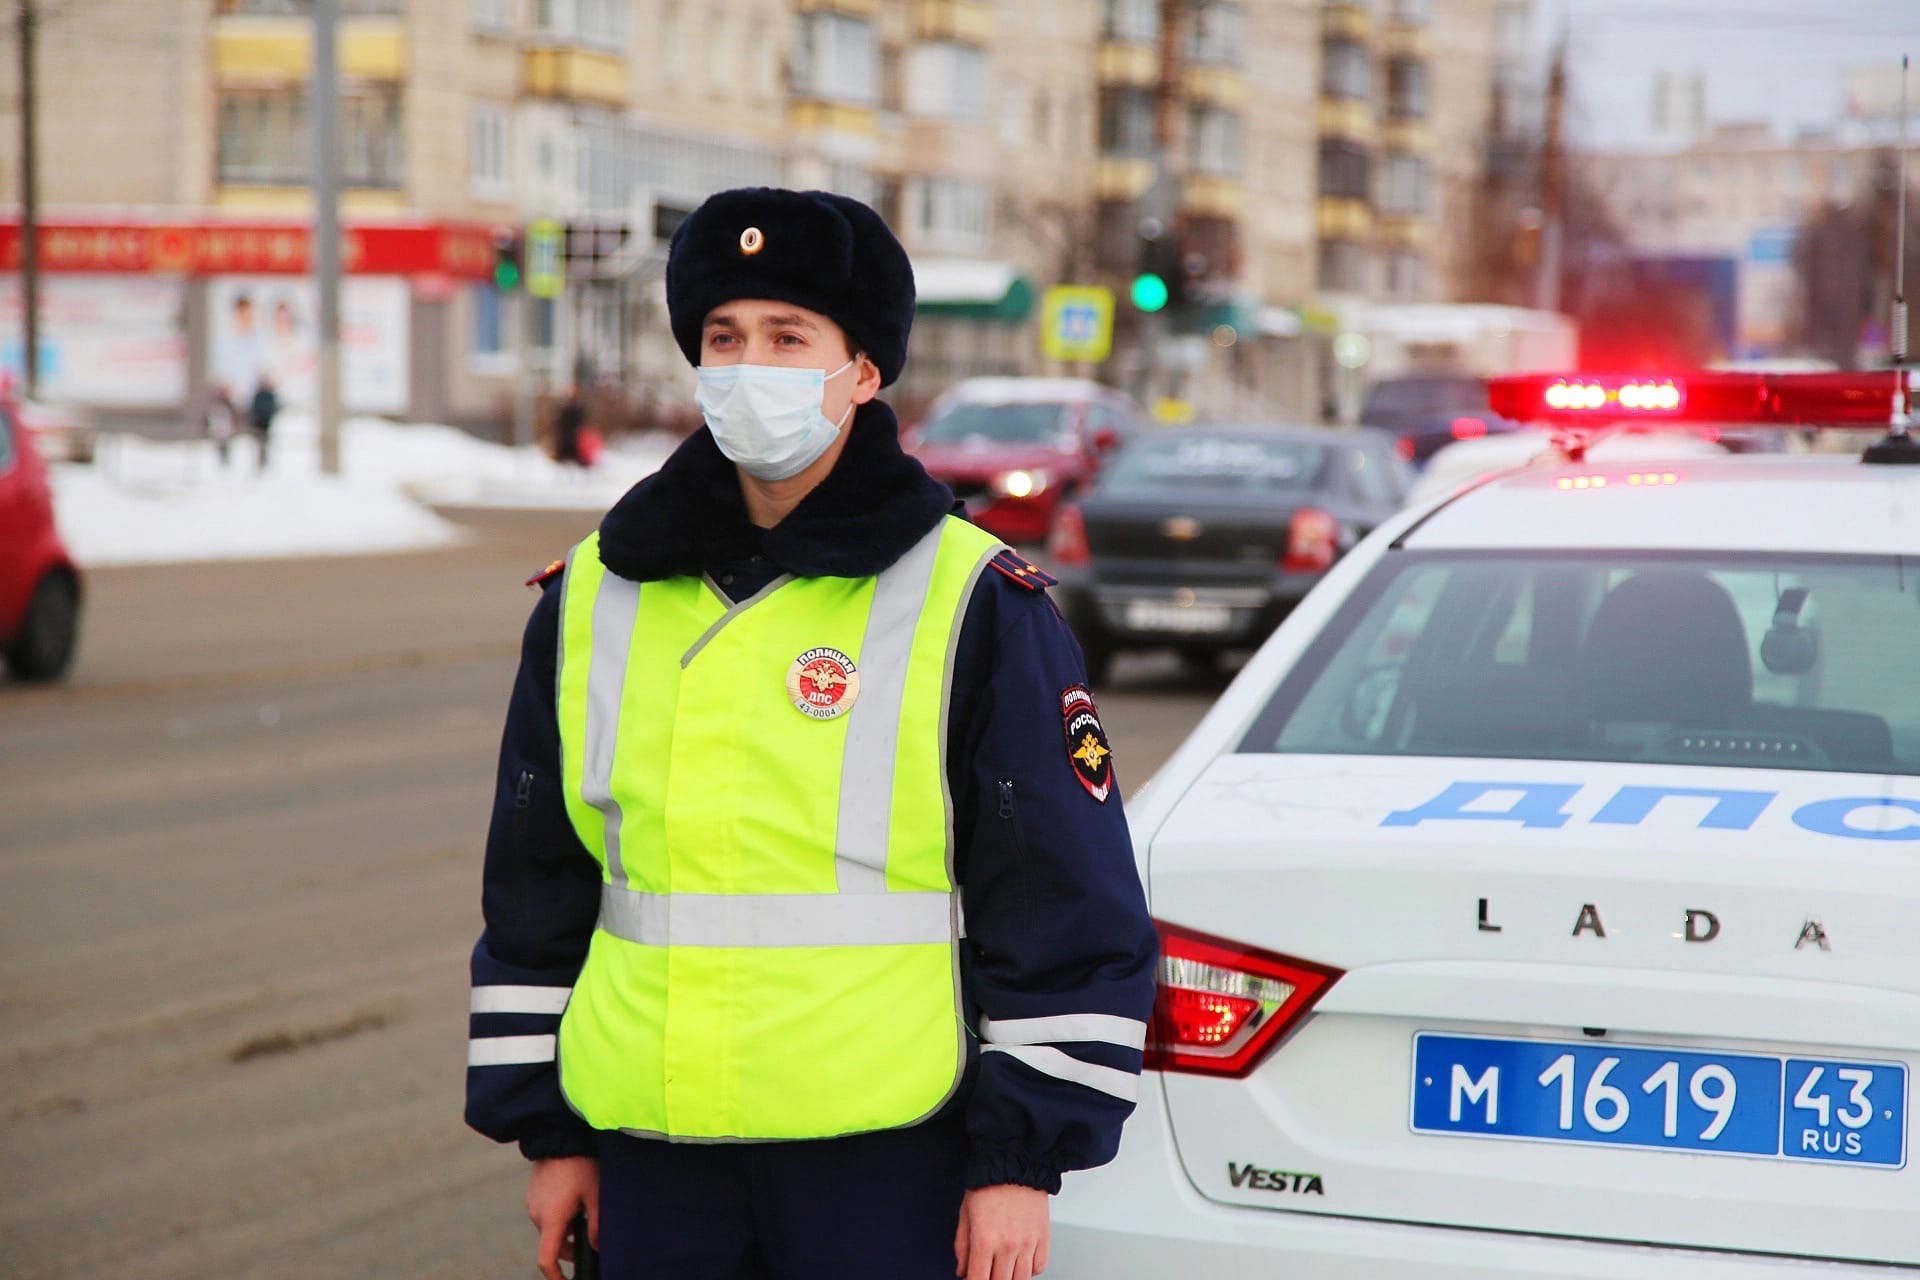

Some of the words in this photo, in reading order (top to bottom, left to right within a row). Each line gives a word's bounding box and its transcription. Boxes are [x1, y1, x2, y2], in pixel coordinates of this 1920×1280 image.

[798, 648, 855, 674] ПОЛИЦИЯ
[799, 702, 836, 718] 43-0004
[808, 691, 833, 704] ДПС
[1478, 897, 1832, 952] LADA
[1449, 1063, 1500, 1125] М
[1538, 1054, 1737, 1141] 1619
[1794, 1066, 1873, 1129] 43
[1802, 1128, 1862, 1155] RUS
[1227, 1161, 1325, 1196] VESTA
